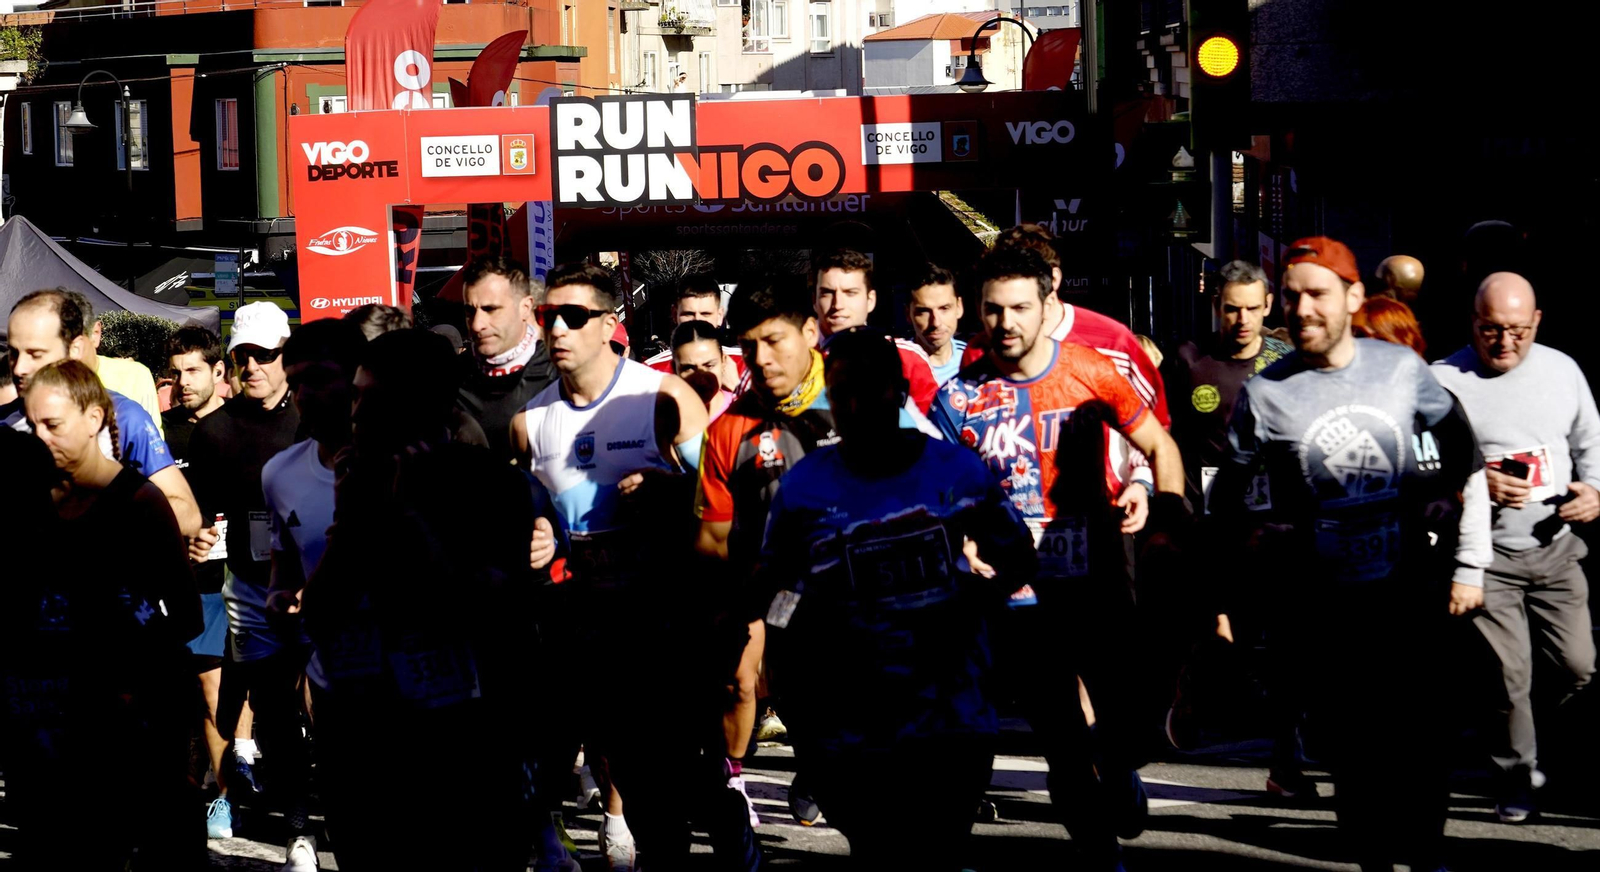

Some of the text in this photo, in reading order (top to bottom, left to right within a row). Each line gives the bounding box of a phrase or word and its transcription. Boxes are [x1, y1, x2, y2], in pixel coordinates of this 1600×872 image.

[556, 99, 691, 150] RUN
[1005, 119, 1076, 146] VIGO
[867, 130, 935, 143] CONCELLO
[301, 140, 369, 166] VIGO
[427, 144, 493, 155] CONCELLO
[876, 143, 928, 155] DE VIGO
[308, 160, 399, 182] DEPORTE
[435, 157, 486, 168] DE VIGO
